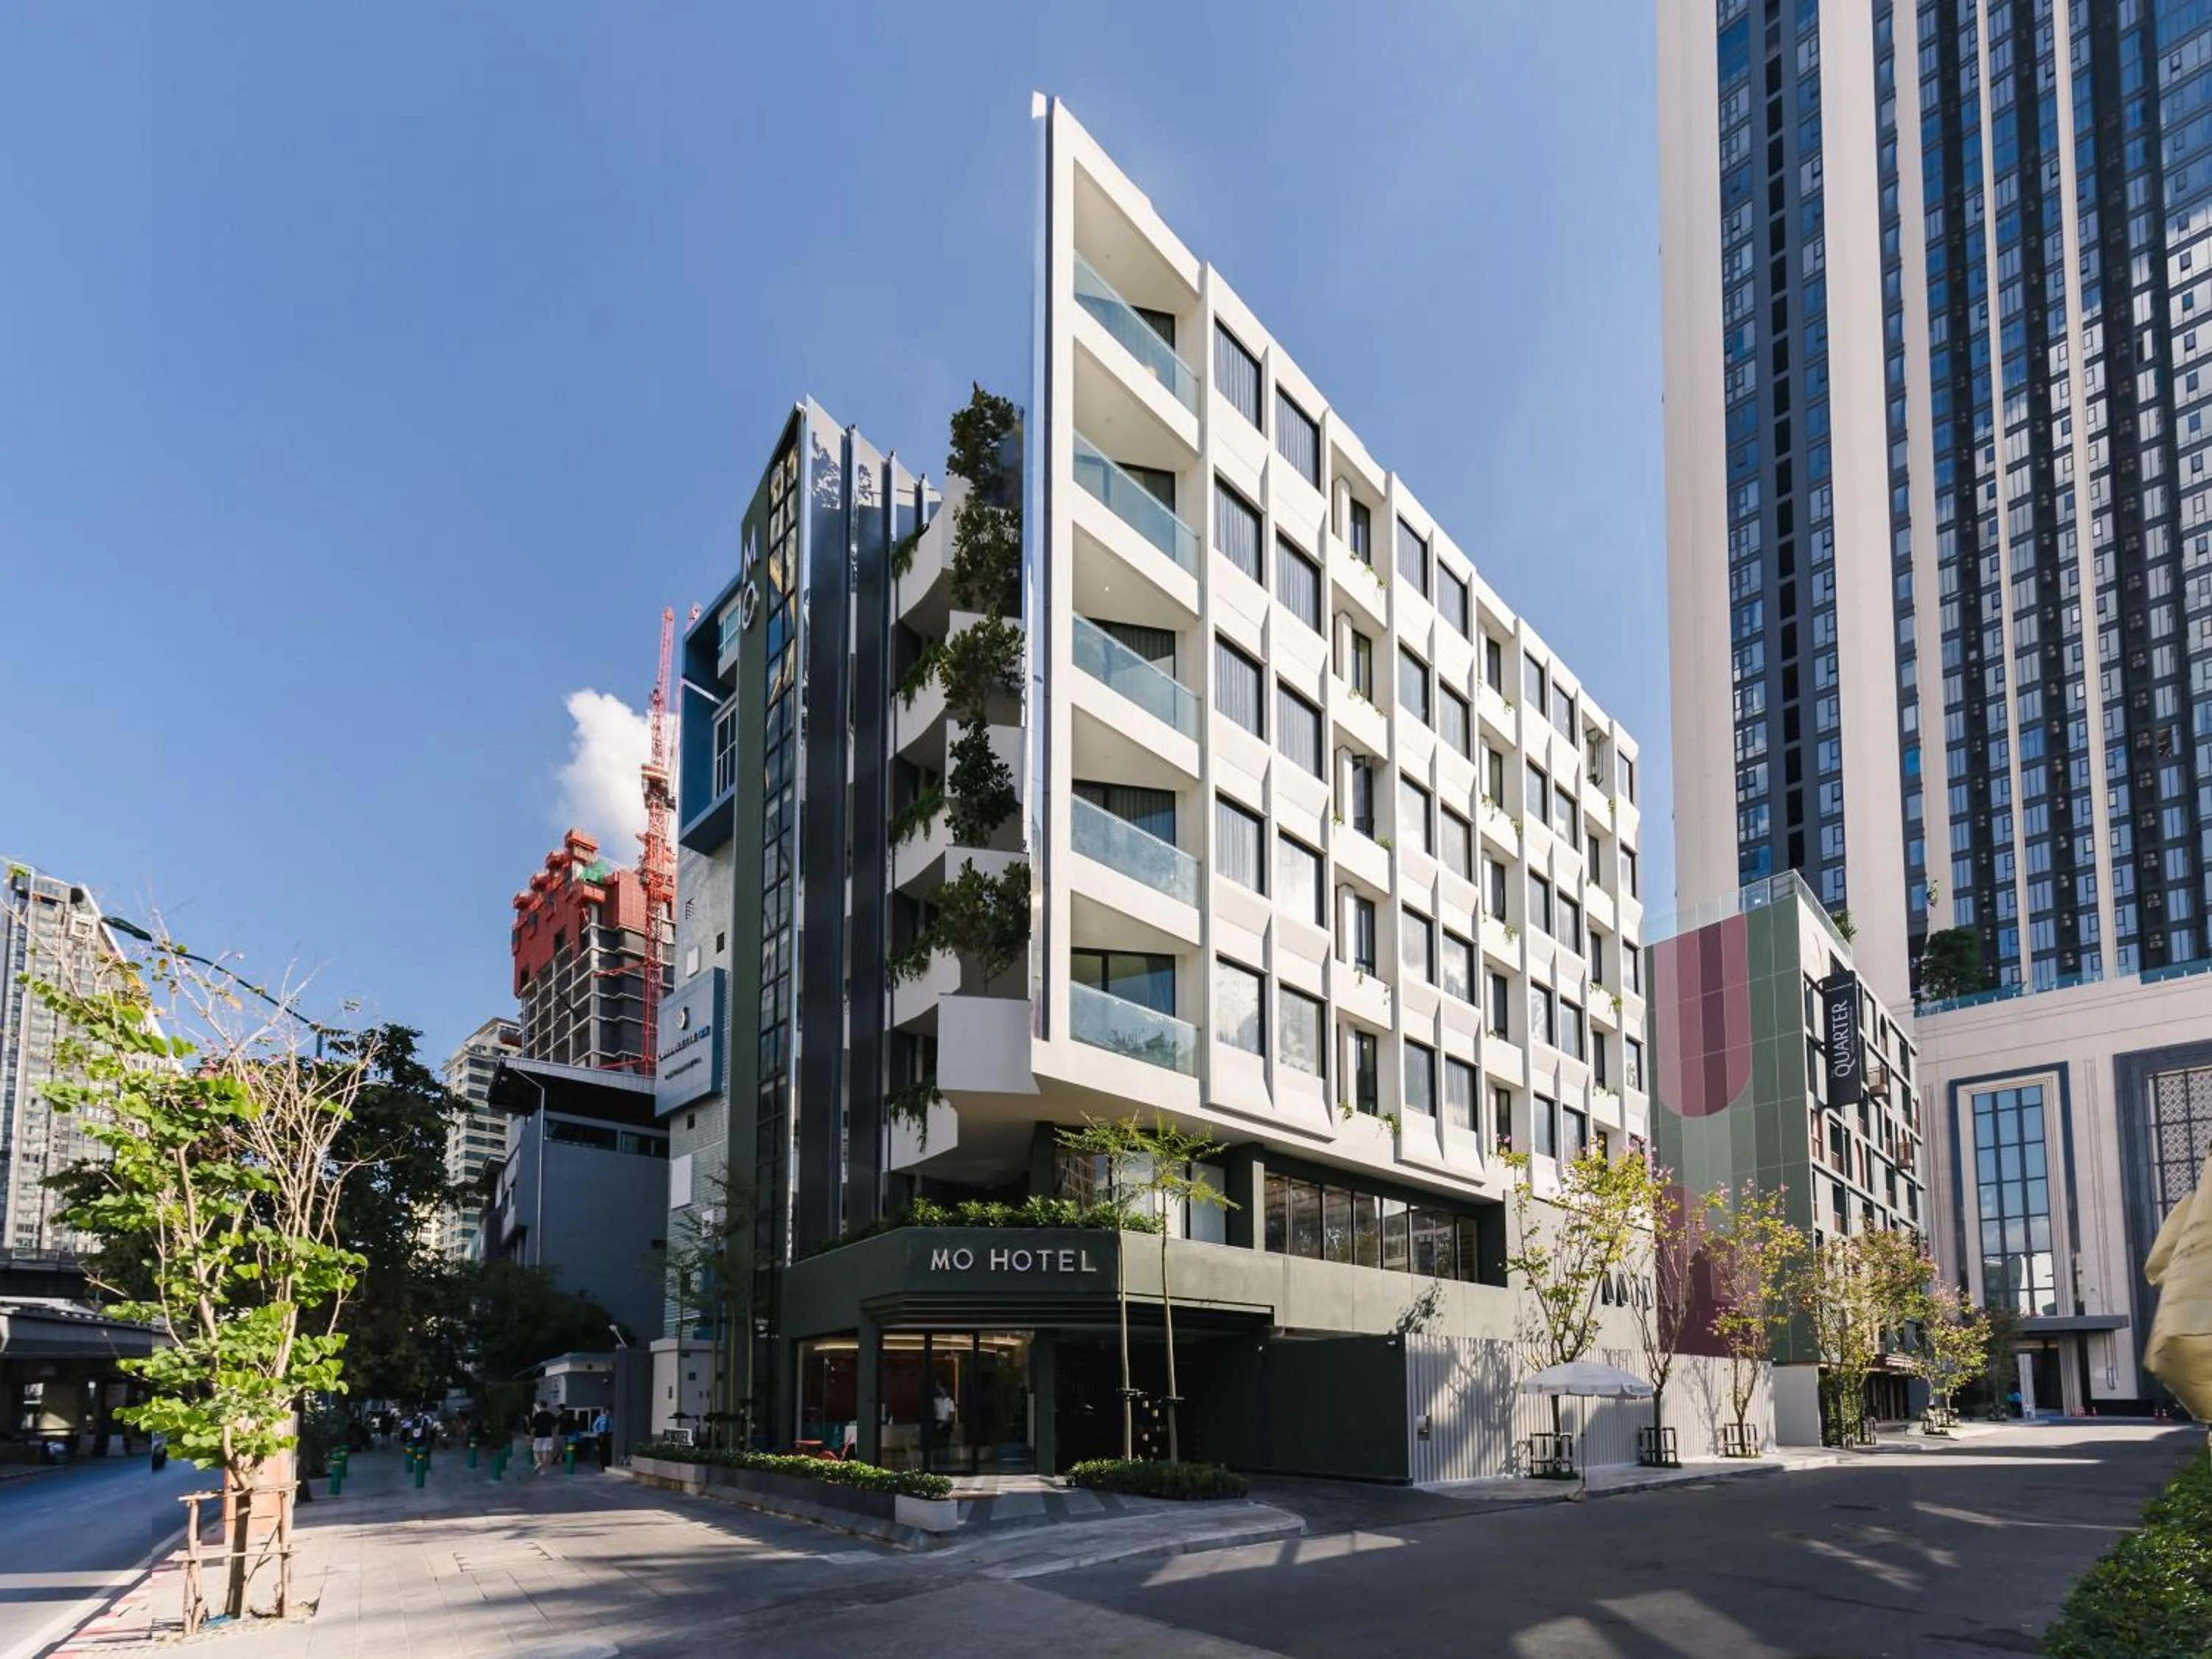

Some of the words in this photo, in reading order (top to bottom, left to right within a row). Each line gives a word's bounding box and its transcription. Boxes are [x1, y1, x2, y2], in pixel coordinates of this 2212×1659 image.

[742, 524, 759, 630] MO
[1832, 999, 1856, 1078] QUARTER
[931, 1248, 974, 1270] MO
[990, 1248, 1097, 1272] HOTEL
